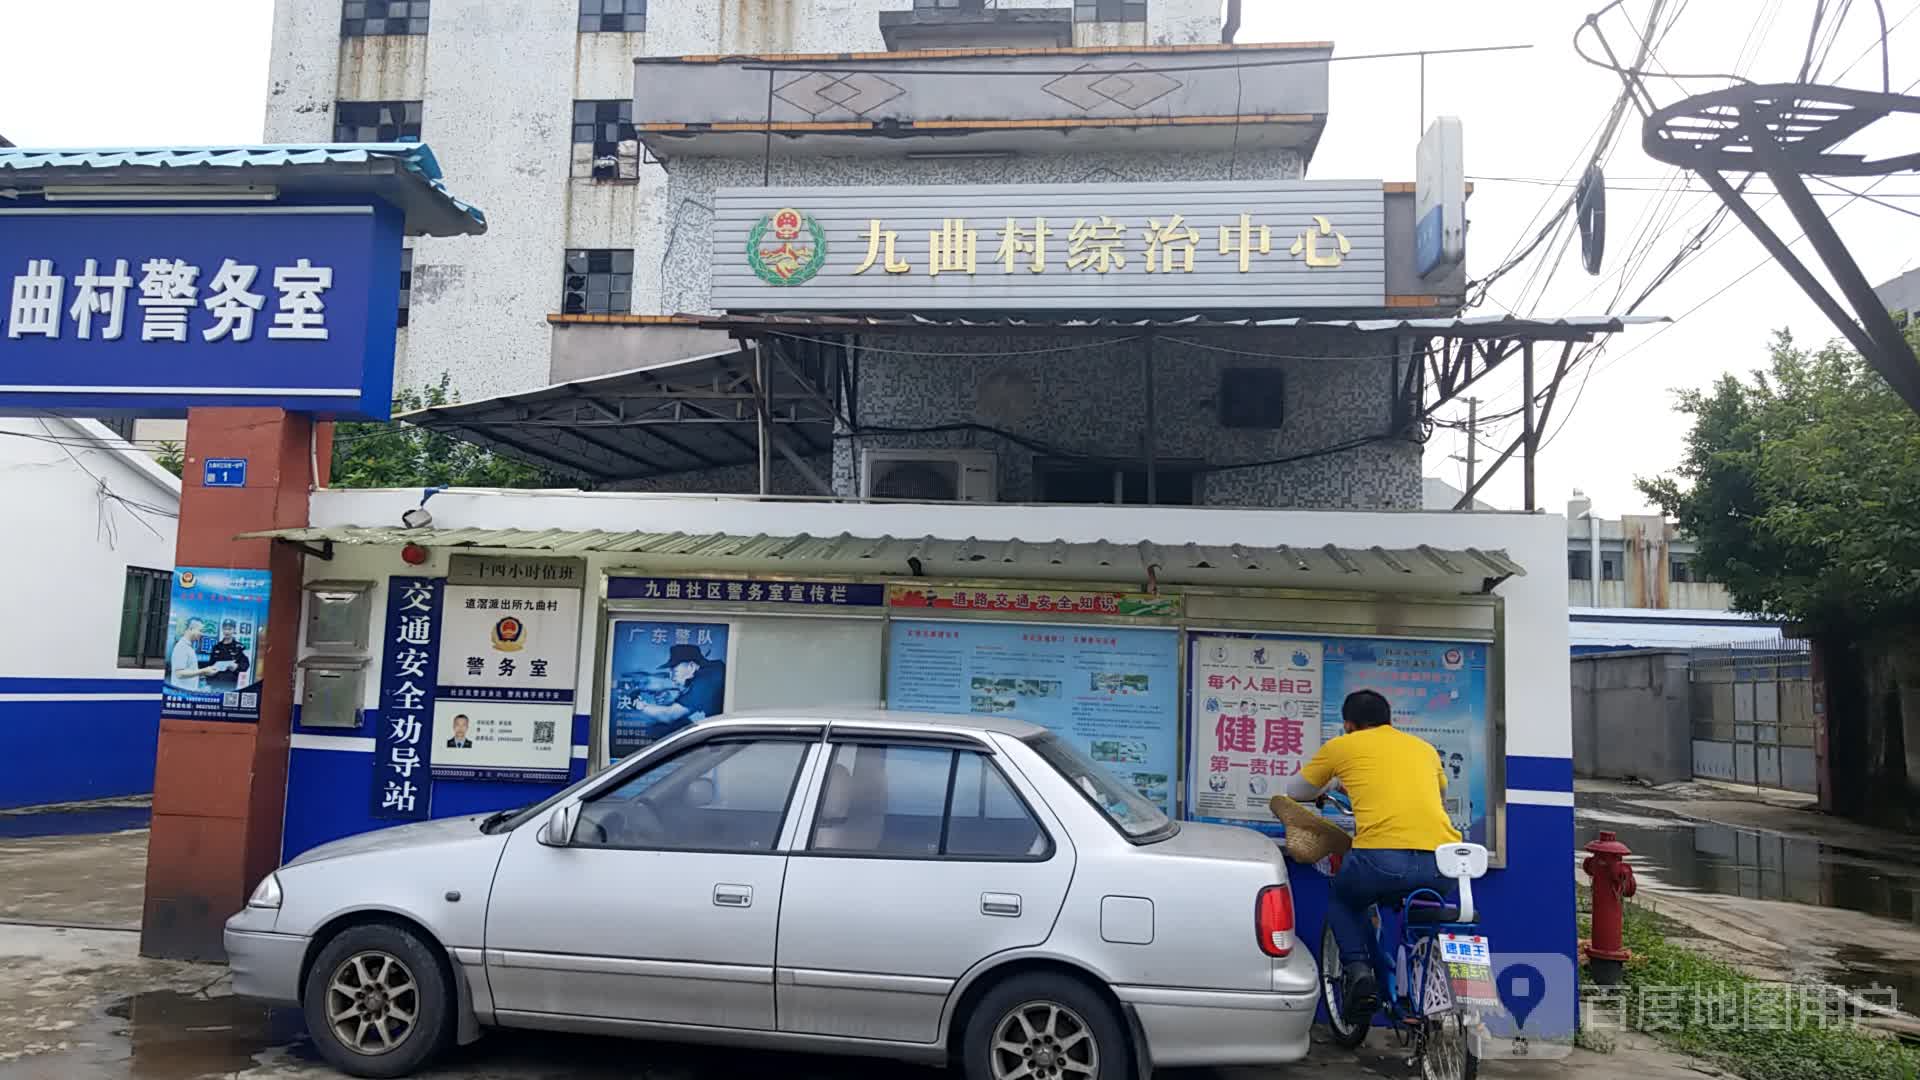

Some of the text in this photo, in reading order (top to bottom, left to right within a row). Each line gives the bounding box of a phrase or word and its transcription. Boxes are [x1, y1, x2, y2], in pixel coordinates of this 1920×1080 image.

[854, 214, 1352, 278] 九曲村综治中心
[0, 258, 334, 342] 曲村警务室
[463, 561, 577, 581] 二十四小时值班
[644, 580, 848, 604] 九曲社区警务室宣传栏
[953, 591, 1117, 612] 道路交通安全知识
[628, 628, 713, 646] 广东警队
[466, 656, 549, 677] 警务室
[1208, 674, 1313, 694] 每个人是自己
[382, 581, 434, 813] 交通安全劝导站
[1214, 713, 1304, 756] 健康
